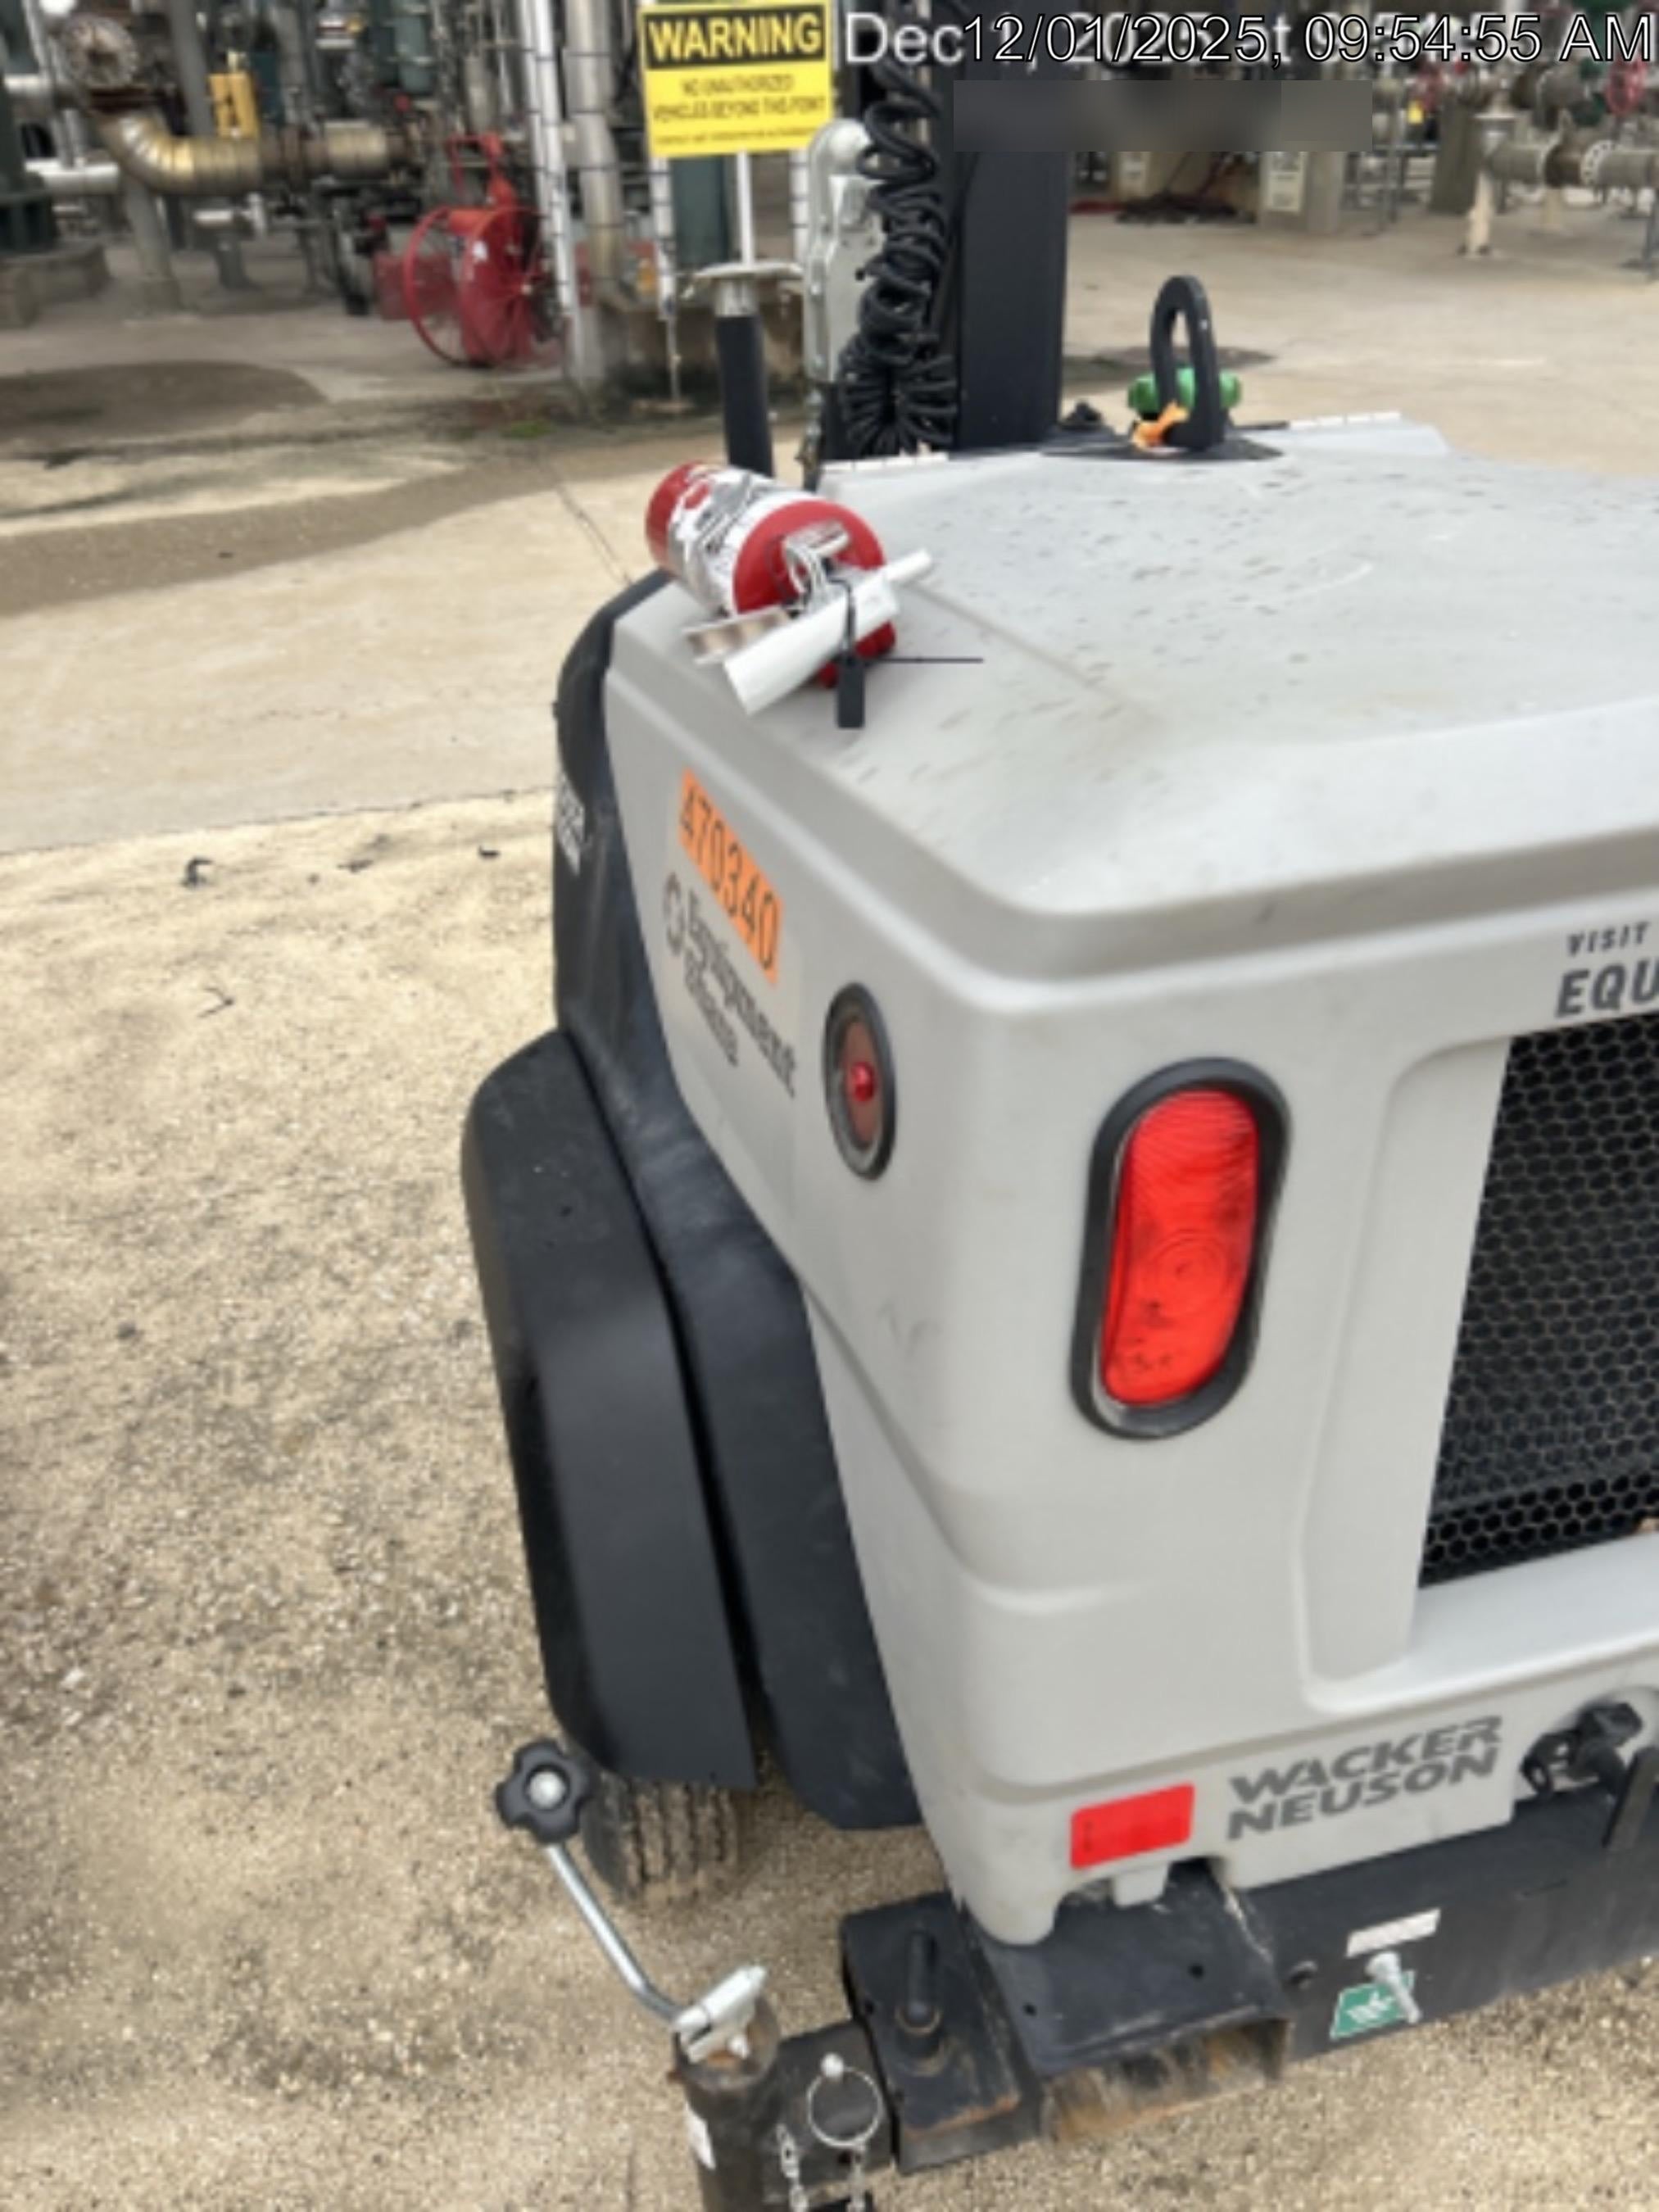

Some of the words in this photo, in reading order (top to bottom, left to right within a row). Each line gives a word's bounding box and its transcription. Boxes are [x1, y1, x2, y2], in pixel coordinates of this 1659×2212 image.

[648, 12, 821, 62] WARNING
[680, 786, 780, 971] 470340
[1566, 921, 1650, 958] VISIT
[1555, 957, 1659, 1019] EQU
[1226, 1746, 1499, 1840] NEUSON
[1229, 1716, 1503, 1803] WACKER
